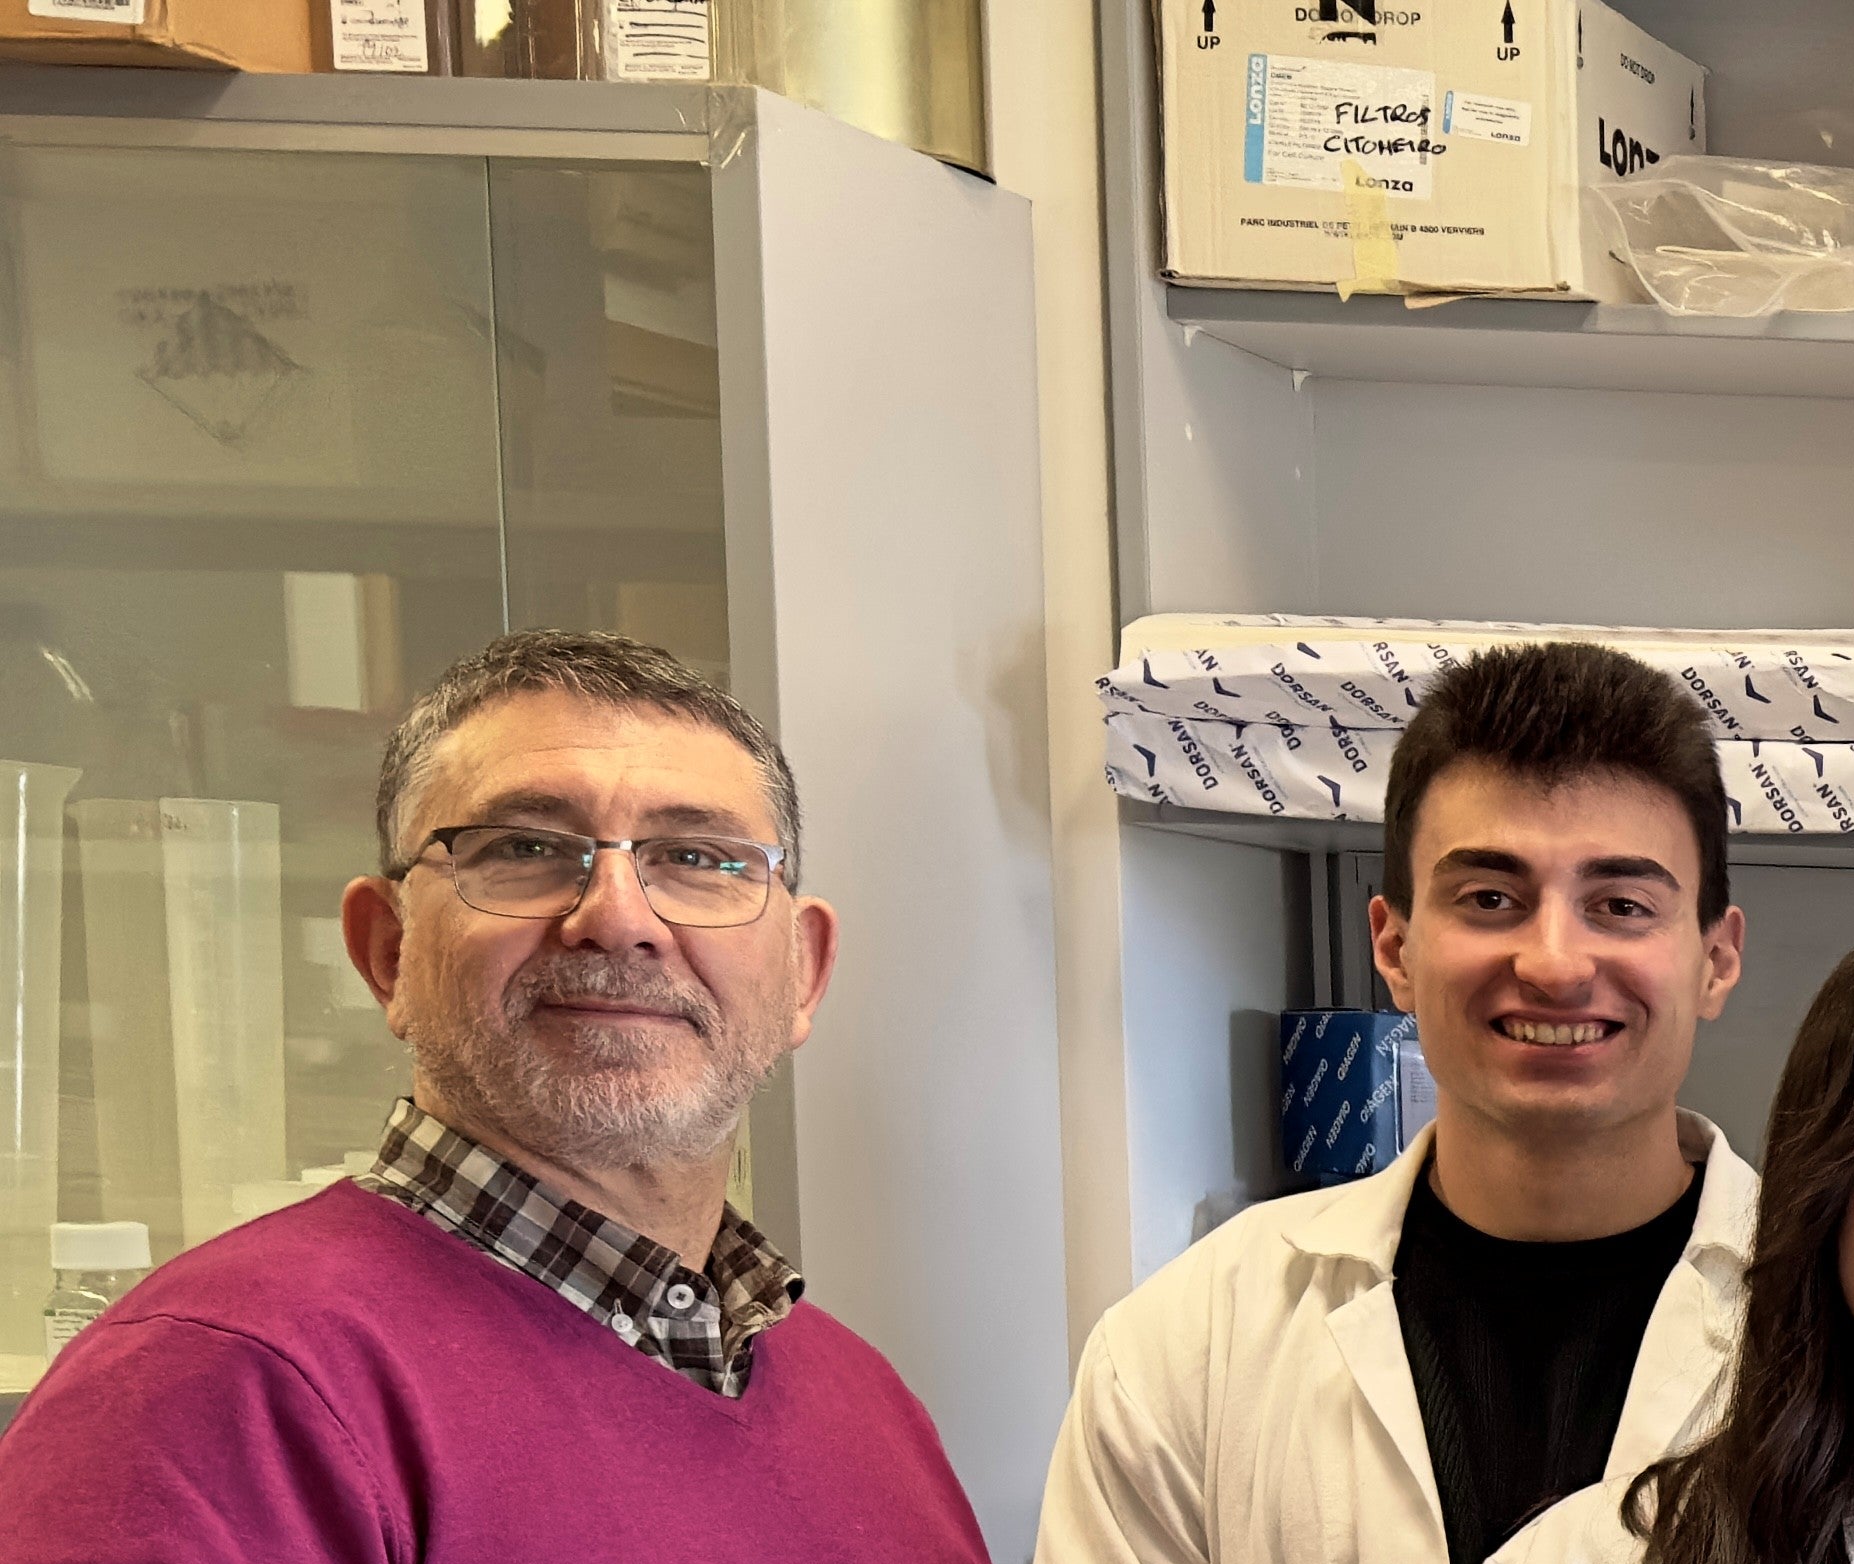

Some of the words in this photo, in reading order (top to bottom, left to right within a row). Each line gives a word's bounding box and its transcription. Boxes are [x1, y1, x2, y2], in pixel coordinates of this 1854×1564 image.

[1197, 35, 1221, 50] UP
[1497, 47, 1521, 61] UP
[1334, 102, 1432, 127] FILTROS
[1355, 175, 1414, 193] Lonza
[1269, 661, 1334, 714] DORSAN
[1340, 681, 1405, 724] DORSAN
[1680, 666, 1740, 730] DORSAN
[1167, 719, 1220, 791] DORSAN
[1230, 744, 1287, 816] DORSAN
[1751, 763, 1805, 833] DORSAN
[1283, 1017, 1307, 1066] QIAGEN
[1337, 1032, 1362, 1082] QIAGEN
[1303, 1058, 1328, 1108] QIAGEN
[1293, 1124, 1318, 1172] QIAGEN
[1325, 1100, 1351, 1150] QIAGEN
